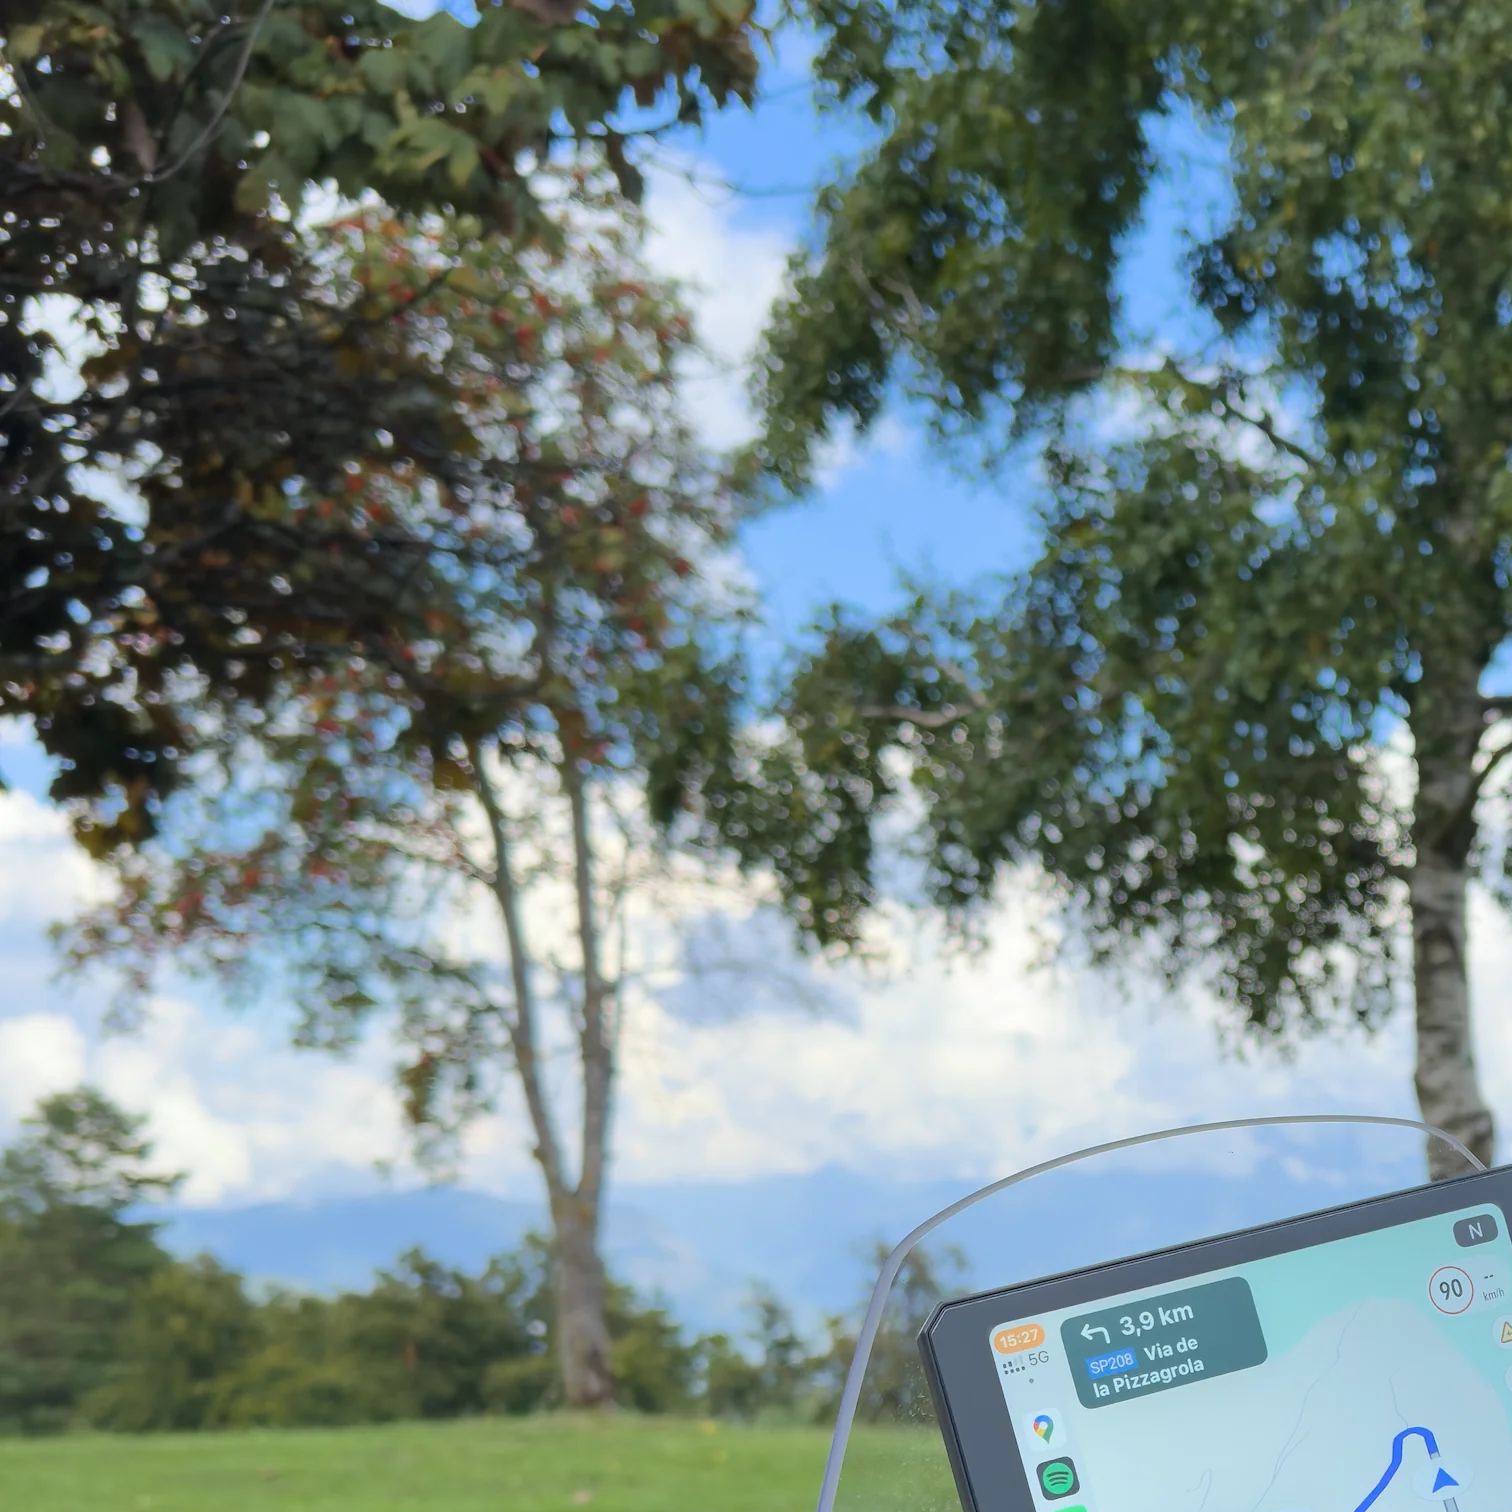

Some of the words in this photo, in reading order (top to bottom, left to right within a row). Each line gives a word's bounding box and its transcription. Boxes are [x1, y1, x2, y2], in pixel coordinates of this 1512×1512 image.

[1468, 1222, 1483, 1240] N
[1439, 1278, 1463, 1301] 90
[1482, 1287, 1505, 1301] km/h
[1119, 1310, 1156, 1337] 3,9
[1158, 1303, 1194, 1327] km
[999, 1328, 1040, 1349] 15:27
[1028, 1350, 1050, 1367] 5G
[1089, 1352, 1135, 1375] SP208
[1144, 1342, 1174, 1361] Via
[1176, 1335, 1199, 1353] de
[1093, 1381, 1110, 1398] la
[1112, 1357, 1205, 1394] Pizzagrola
